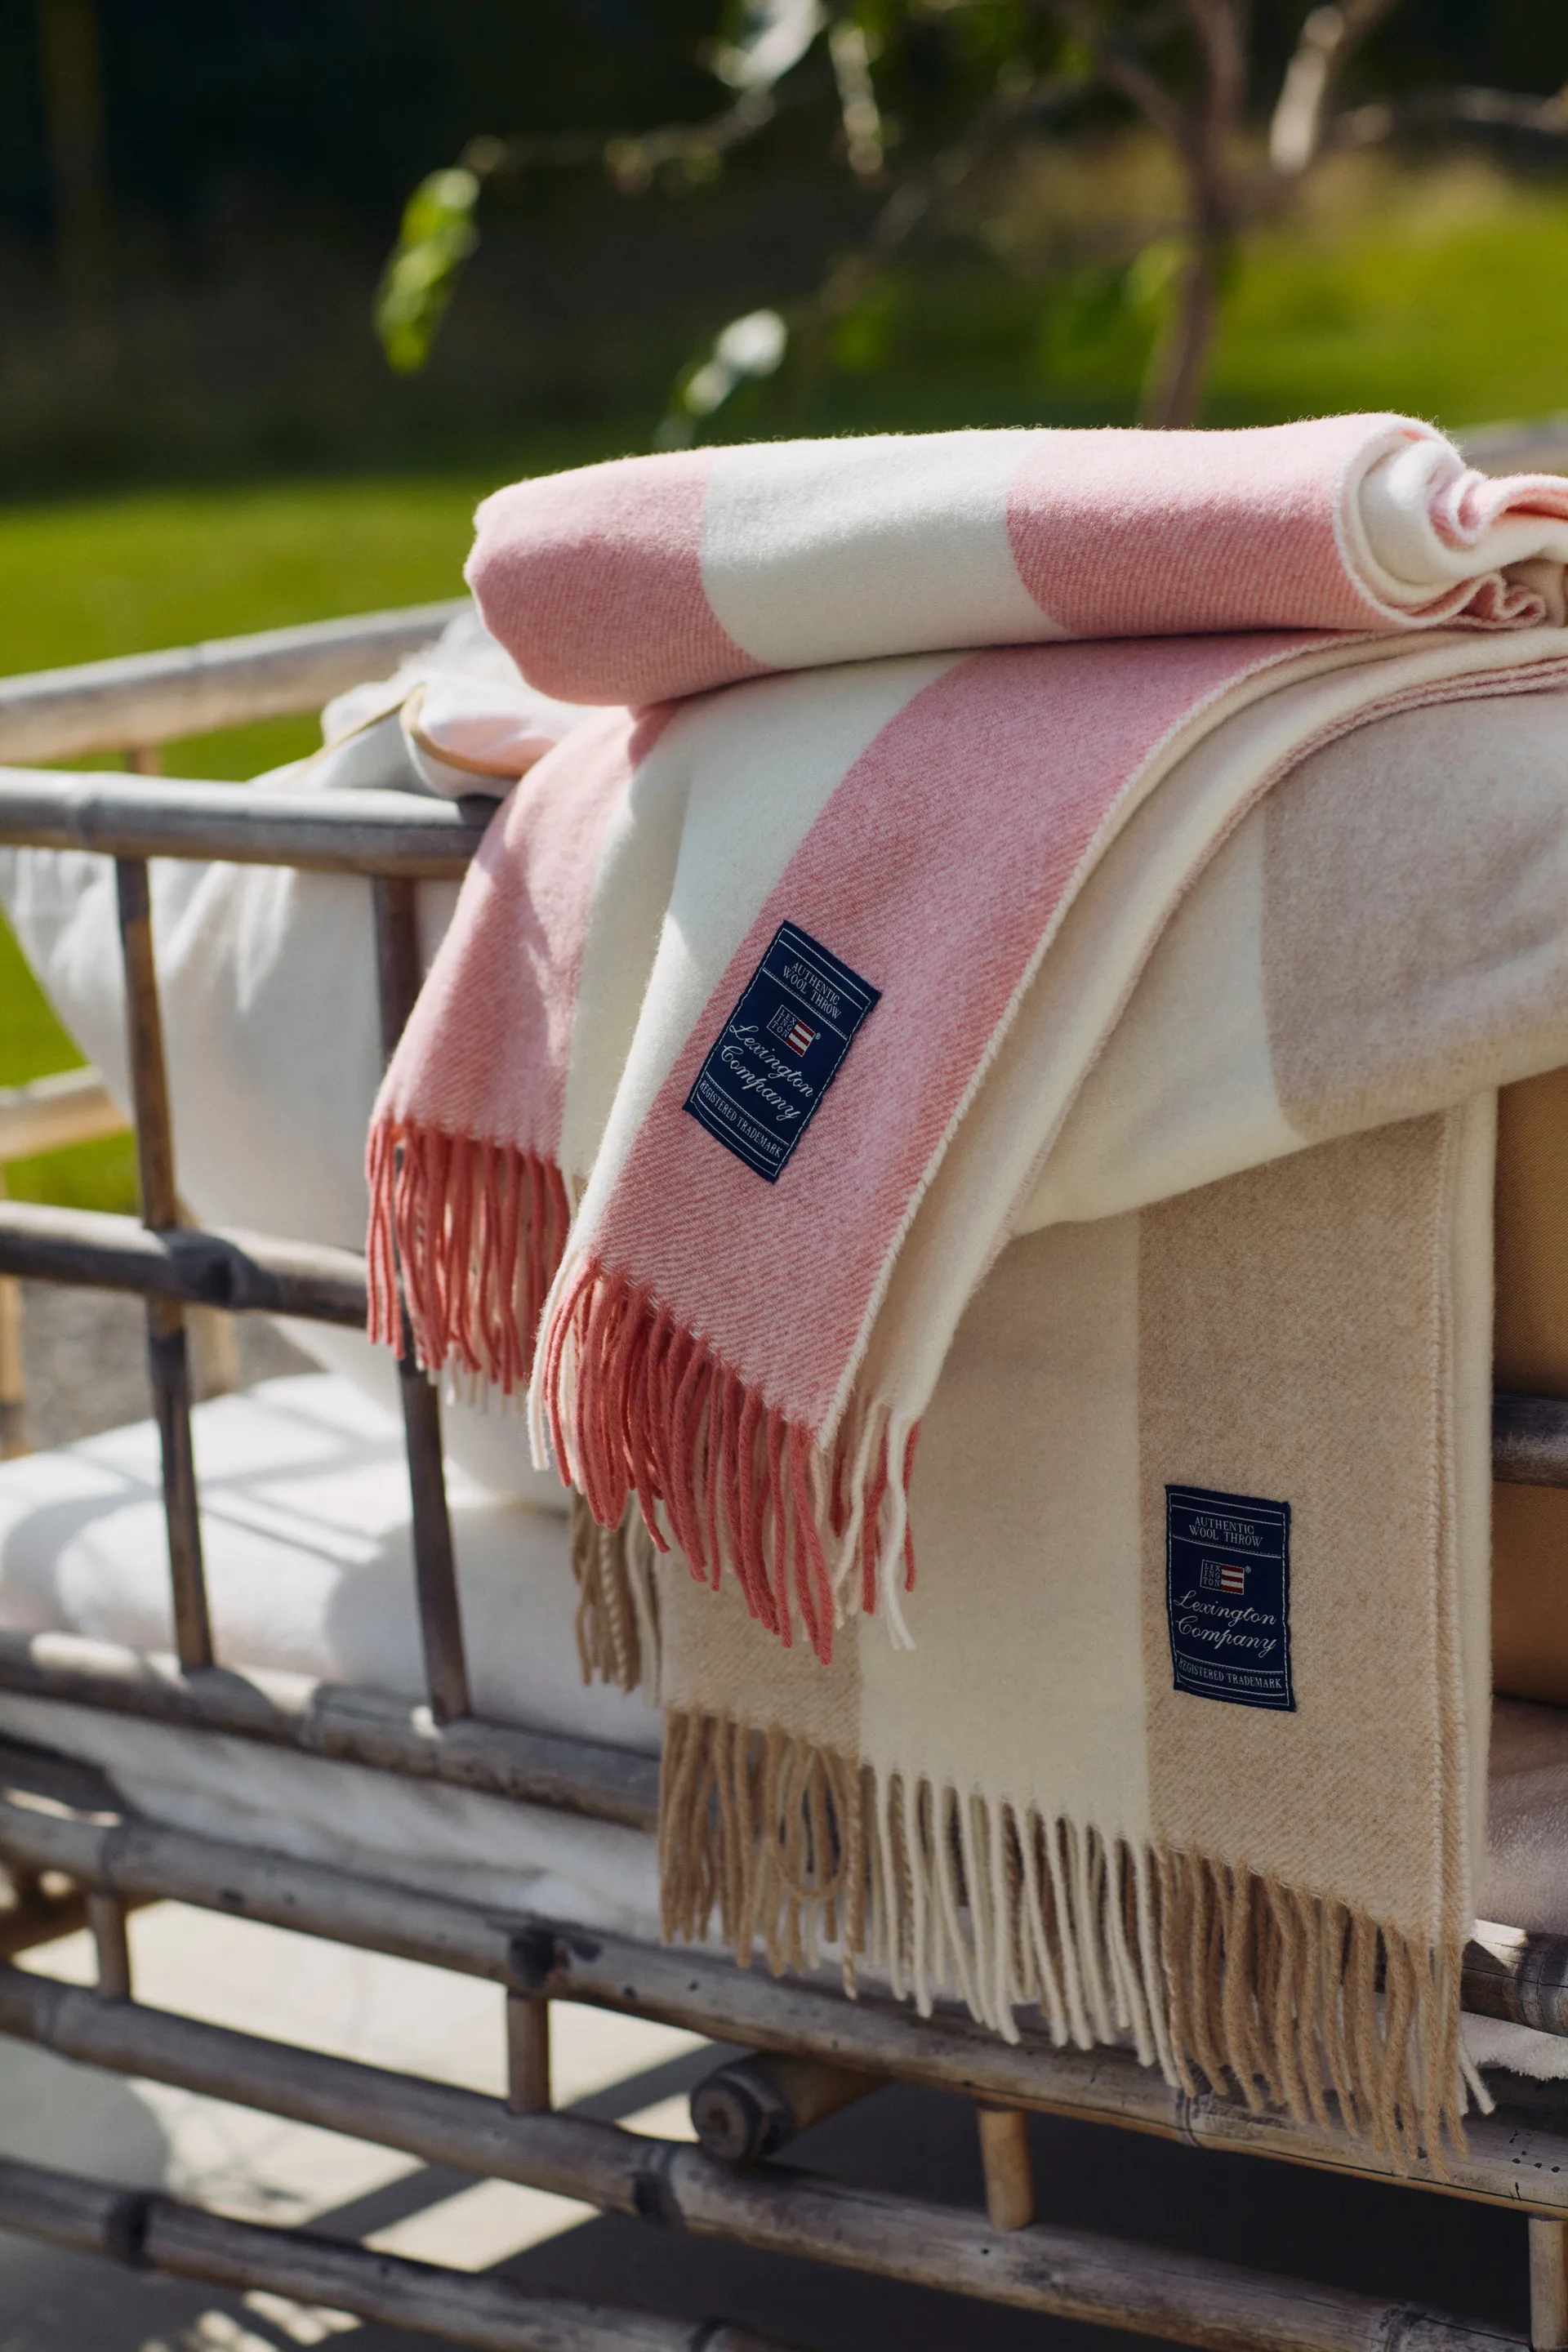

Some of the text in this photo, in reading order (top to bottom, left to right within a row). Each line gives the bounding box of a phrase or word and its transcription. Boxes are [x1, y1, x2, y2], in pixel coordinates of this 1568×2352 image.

[782, 965, 842, 1020] WOOL THROW
[791, 962, 840, 1005] AUTHENTIC
[728, 1024, 813, 1098] Lexington
[720, 1045, 800, 1121] Company
[699, 1080, 783, 1158] REGISTERED TRADEMARK
[1189, 1525, 1263, 1548] WOOL THROW
[1195, 1516, 1255, 1535] AUTHENTIC
[1174, 1590, 1277, 1626] Lexington
[1176, 1615, 1278, 1658] Company
[1178, 1657, 1282, 1689] REGISTERED TRADEMARK
